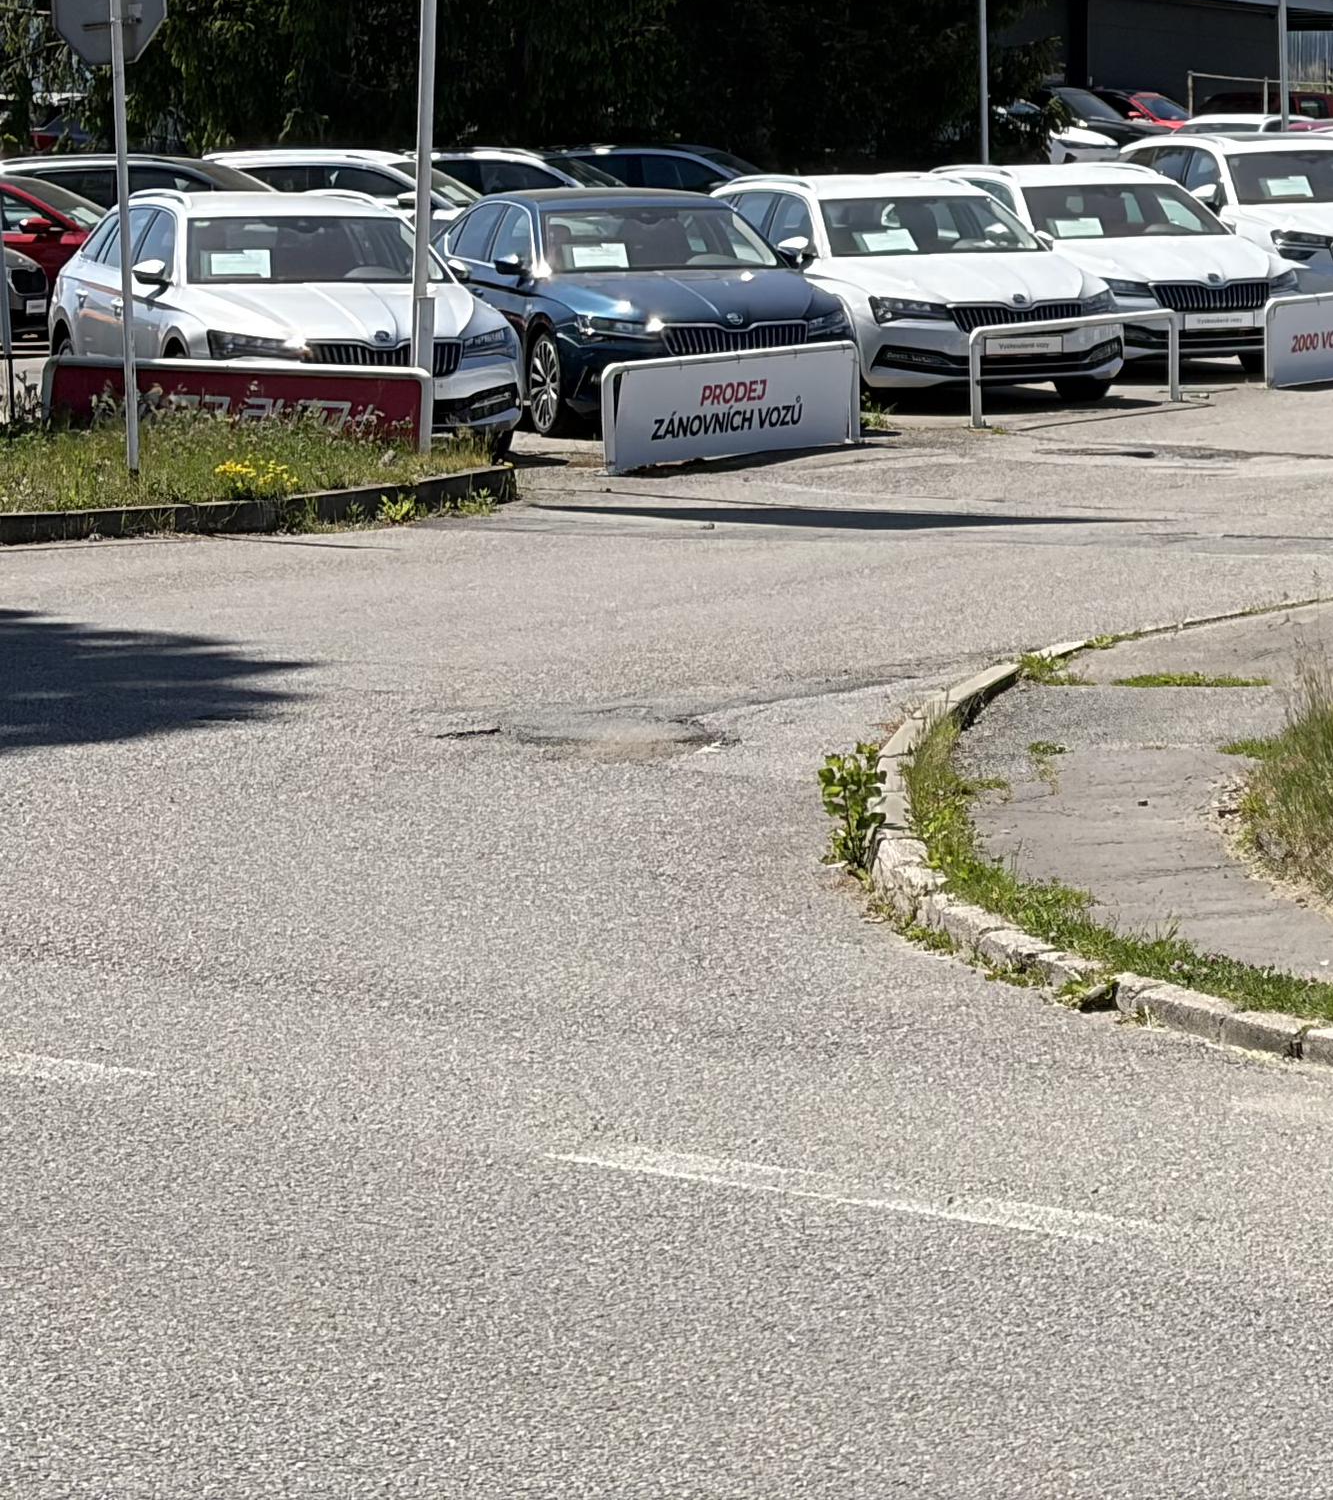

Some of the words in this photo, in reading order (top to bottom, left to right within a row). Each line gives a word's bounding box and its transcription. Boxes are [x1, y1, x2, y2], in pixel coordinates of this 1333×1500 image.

[1291, 332, 1319, 353] 2000
[700, 379, 767, 406] PRODEJ
[651, 404, 753, 441] ZÁNOVNÍCH
[758, 395, 803, 430] VOZŮ
